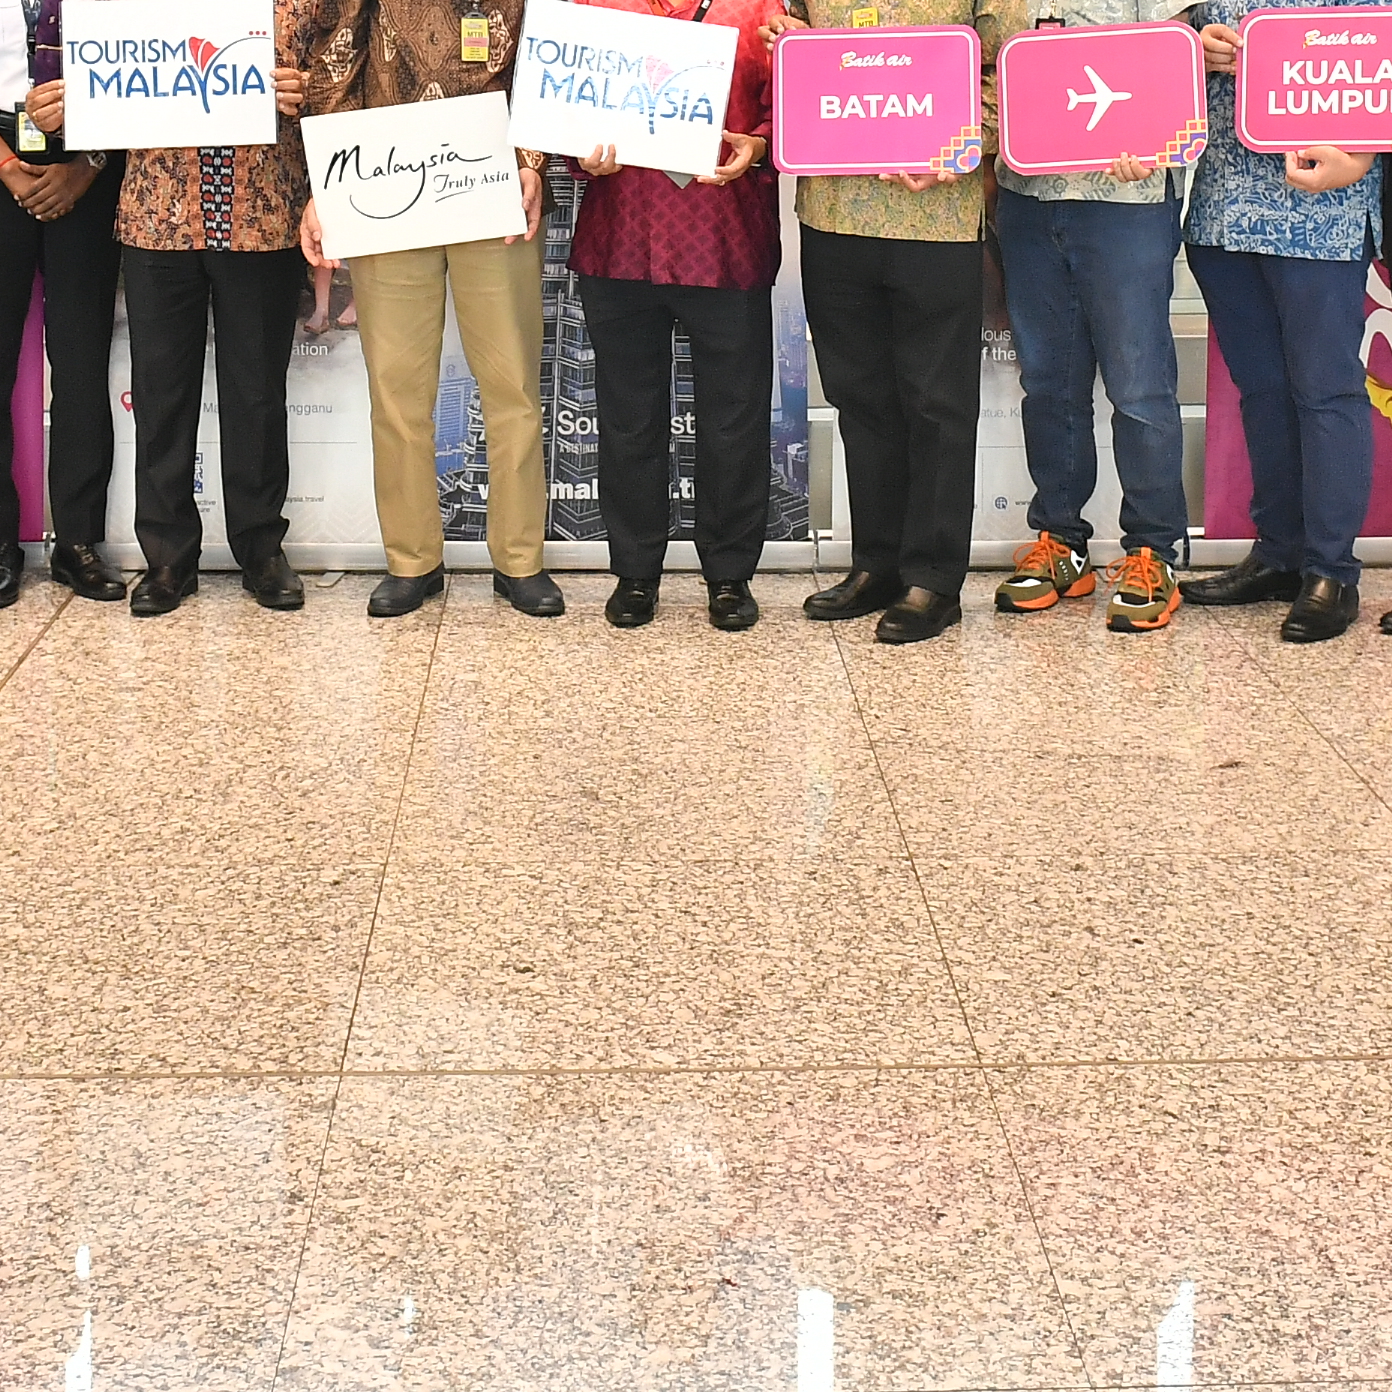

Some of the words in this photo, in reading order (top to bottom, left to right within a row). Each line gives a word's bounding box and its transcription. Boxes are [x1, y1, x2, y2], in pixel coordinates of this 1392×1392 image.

[67, 38, 186, 65] TOURISM
[1302, 29, 1349, 49] Batik
[1351, 32, 1377, 45] air
[526, 36, 644, 78] TOURISM
[839, 50, 885, 71] Batik
[886, 54, 913, 67] air
[89, 63, 267, 114] MALAYSIA
[539, 67, 714, 134] MALAYSIA
[820, 93, 934, 120] BATAM
[324, 143, 493, 220] Malaysia
[433, 173, 476, 194] Truly
[480, 171, 510, 185] Asia
[991, 347, 1017, 361] the
